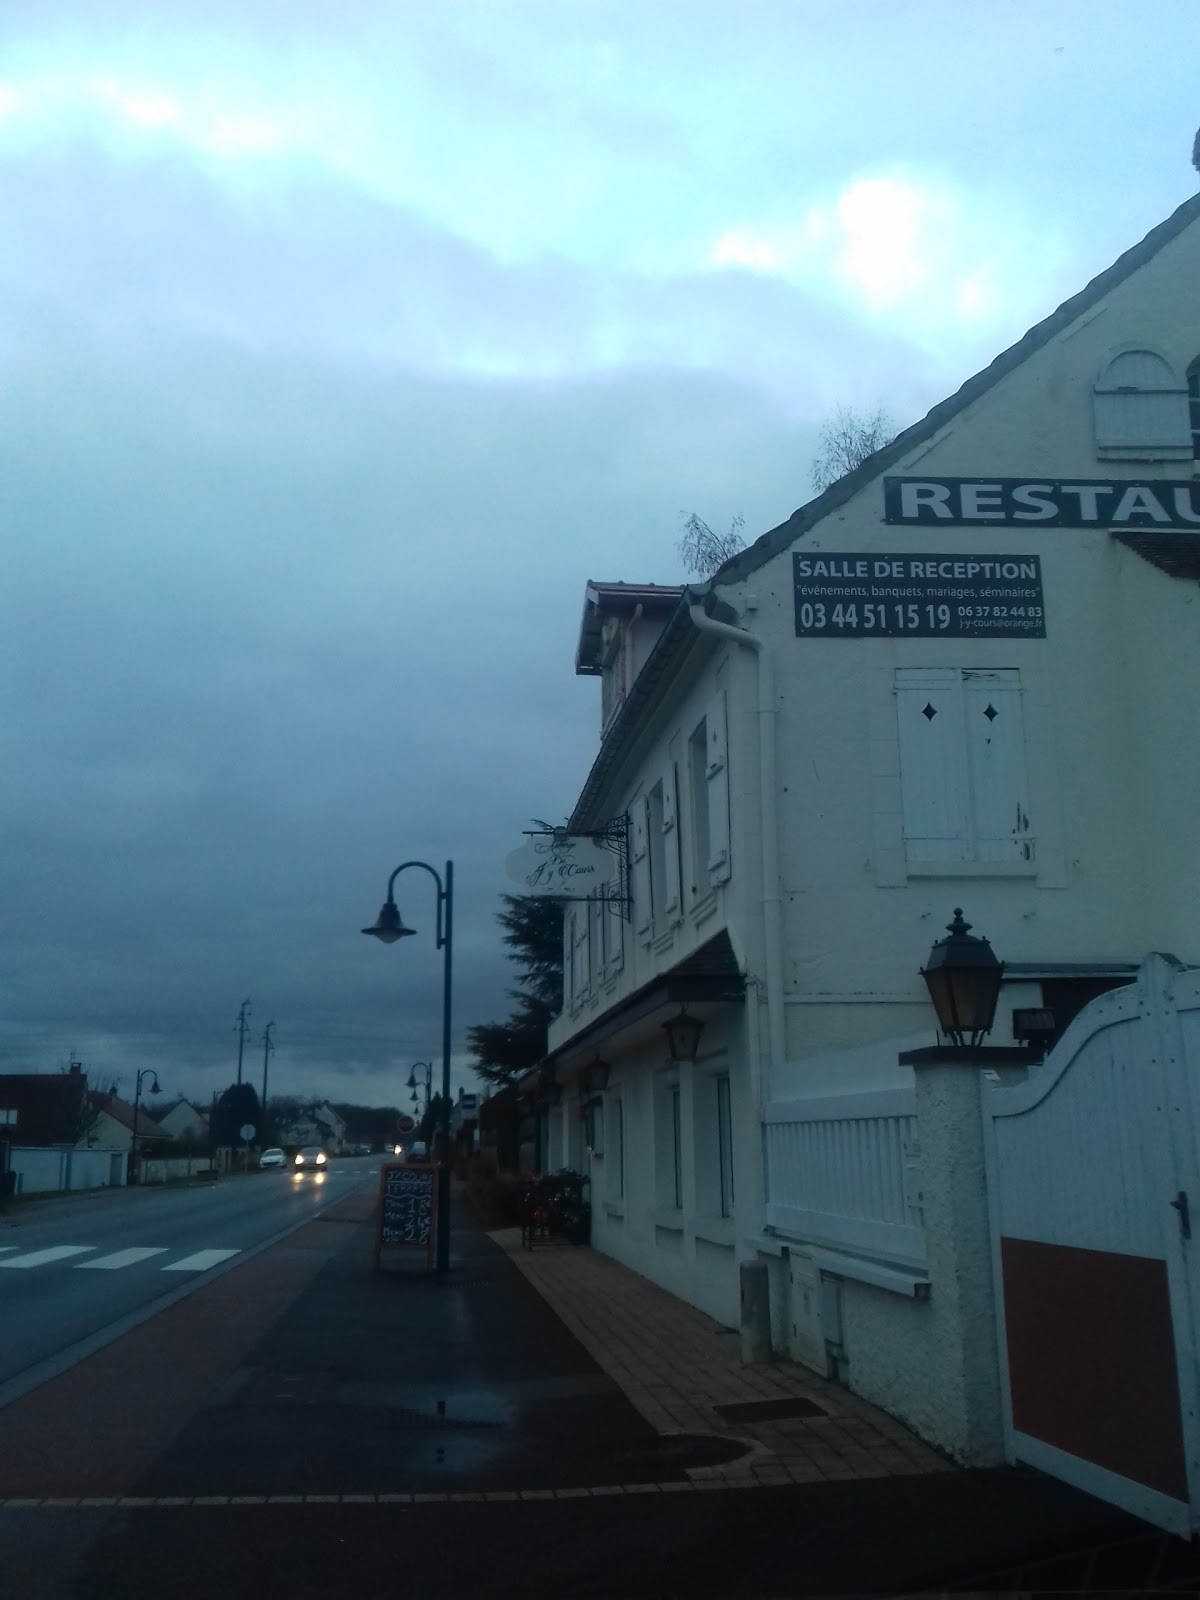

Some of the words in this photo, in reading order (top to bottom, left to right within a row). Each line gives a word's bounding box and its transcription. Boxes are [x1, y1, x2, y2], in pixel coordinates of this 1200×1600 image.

[799, 560, 869, 577] SALLE
[874, 561, 905, 578] DE
[910, 561, 1037, 579] RECEPTION
[871, 585, 924, 599] banquets,
[926, 586, 978, 600] mariages,
[801, 603, 827, 628] 03
[831, 603, 858, 628] 44
[863, 604, 886, 629] 51
[895, 604, 920, 629] 15
[925, 604, 951, 629] 19
[958, 606, 973, 617] 06
[975, 606, 990, 617] 37
[993, 606, 1008, 617] 82
[1010, 606, 1025, 617] 44
[1028, 606, 1042, 617] 83
